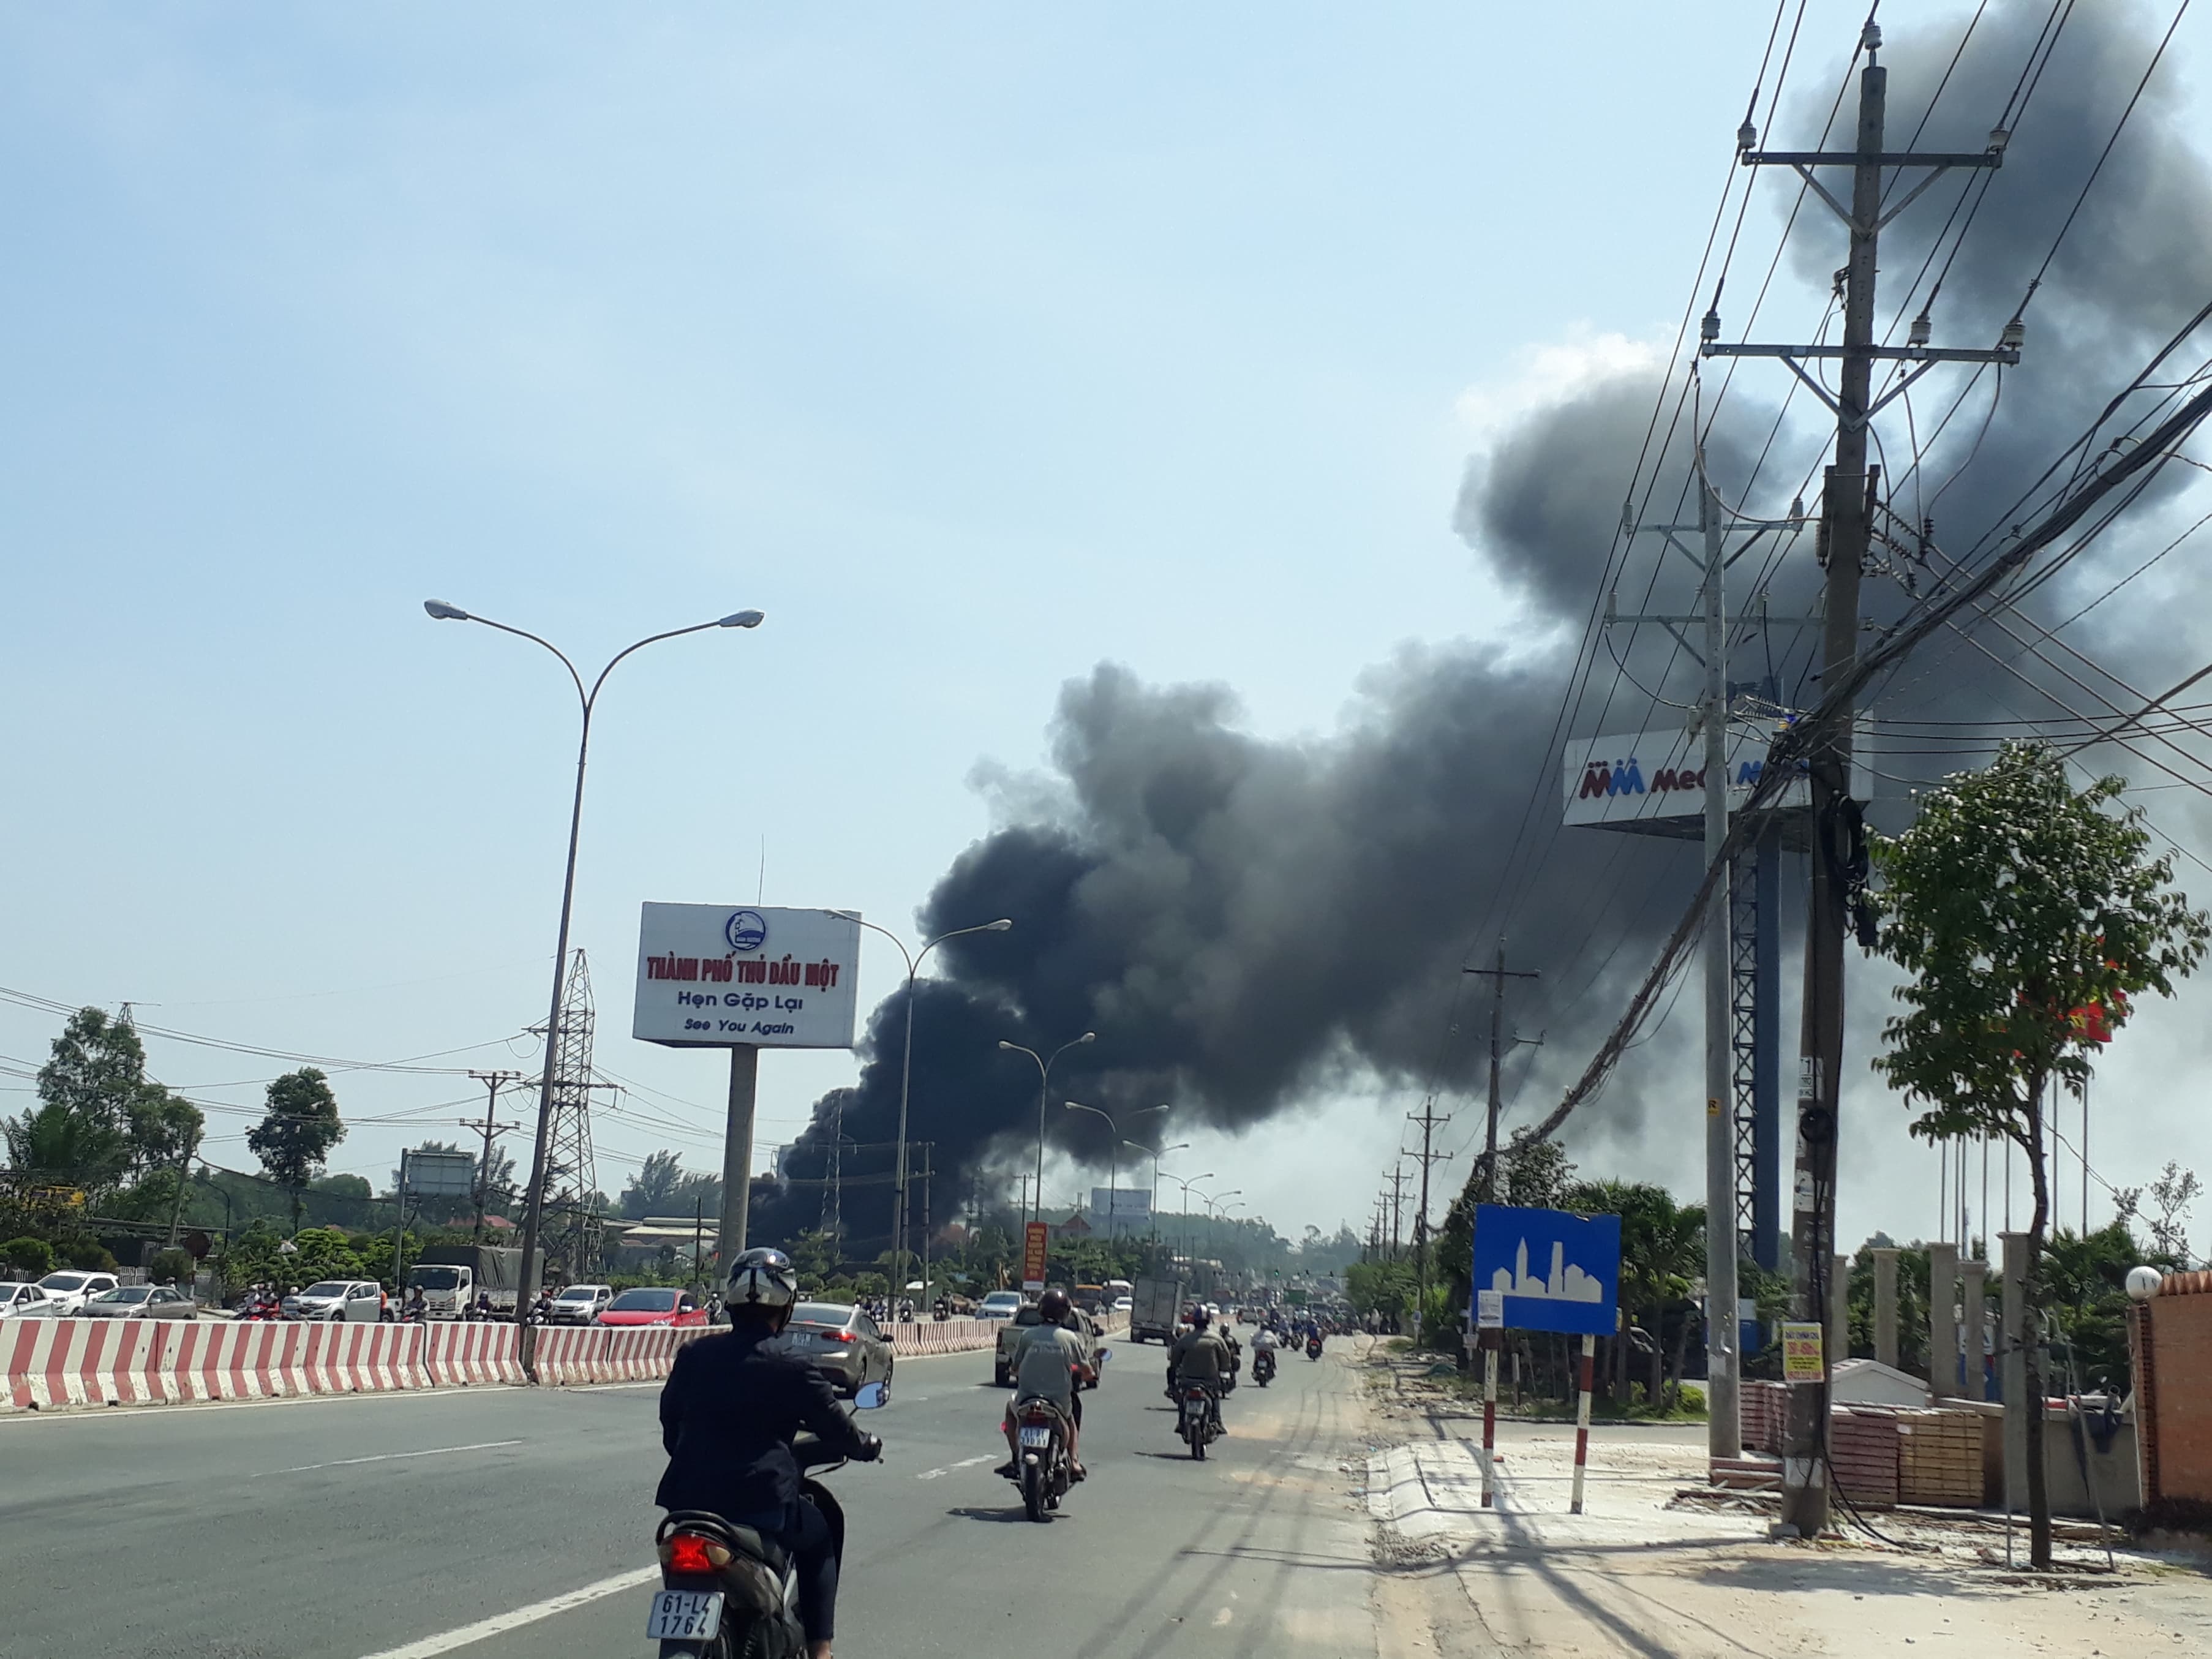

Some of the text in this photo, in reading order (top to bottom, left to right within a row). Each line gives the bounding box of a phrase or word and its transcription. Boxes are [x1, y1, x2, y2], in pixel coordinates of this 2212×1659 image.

[647, 951, 699, 982] THÀNH
[701, 950, 737, 982] PHỐ
[737, 954, 767, 984] THỦ
[804, 958, 840, 992] MỘT
[677, 991, 803, 1014] Hẹn Gặp Lại
[684, 1018, 794, 1036] See You Again
[663, 1594, 711, 1615] 61-L4
[660, 1616, 707, 1636] 1764
